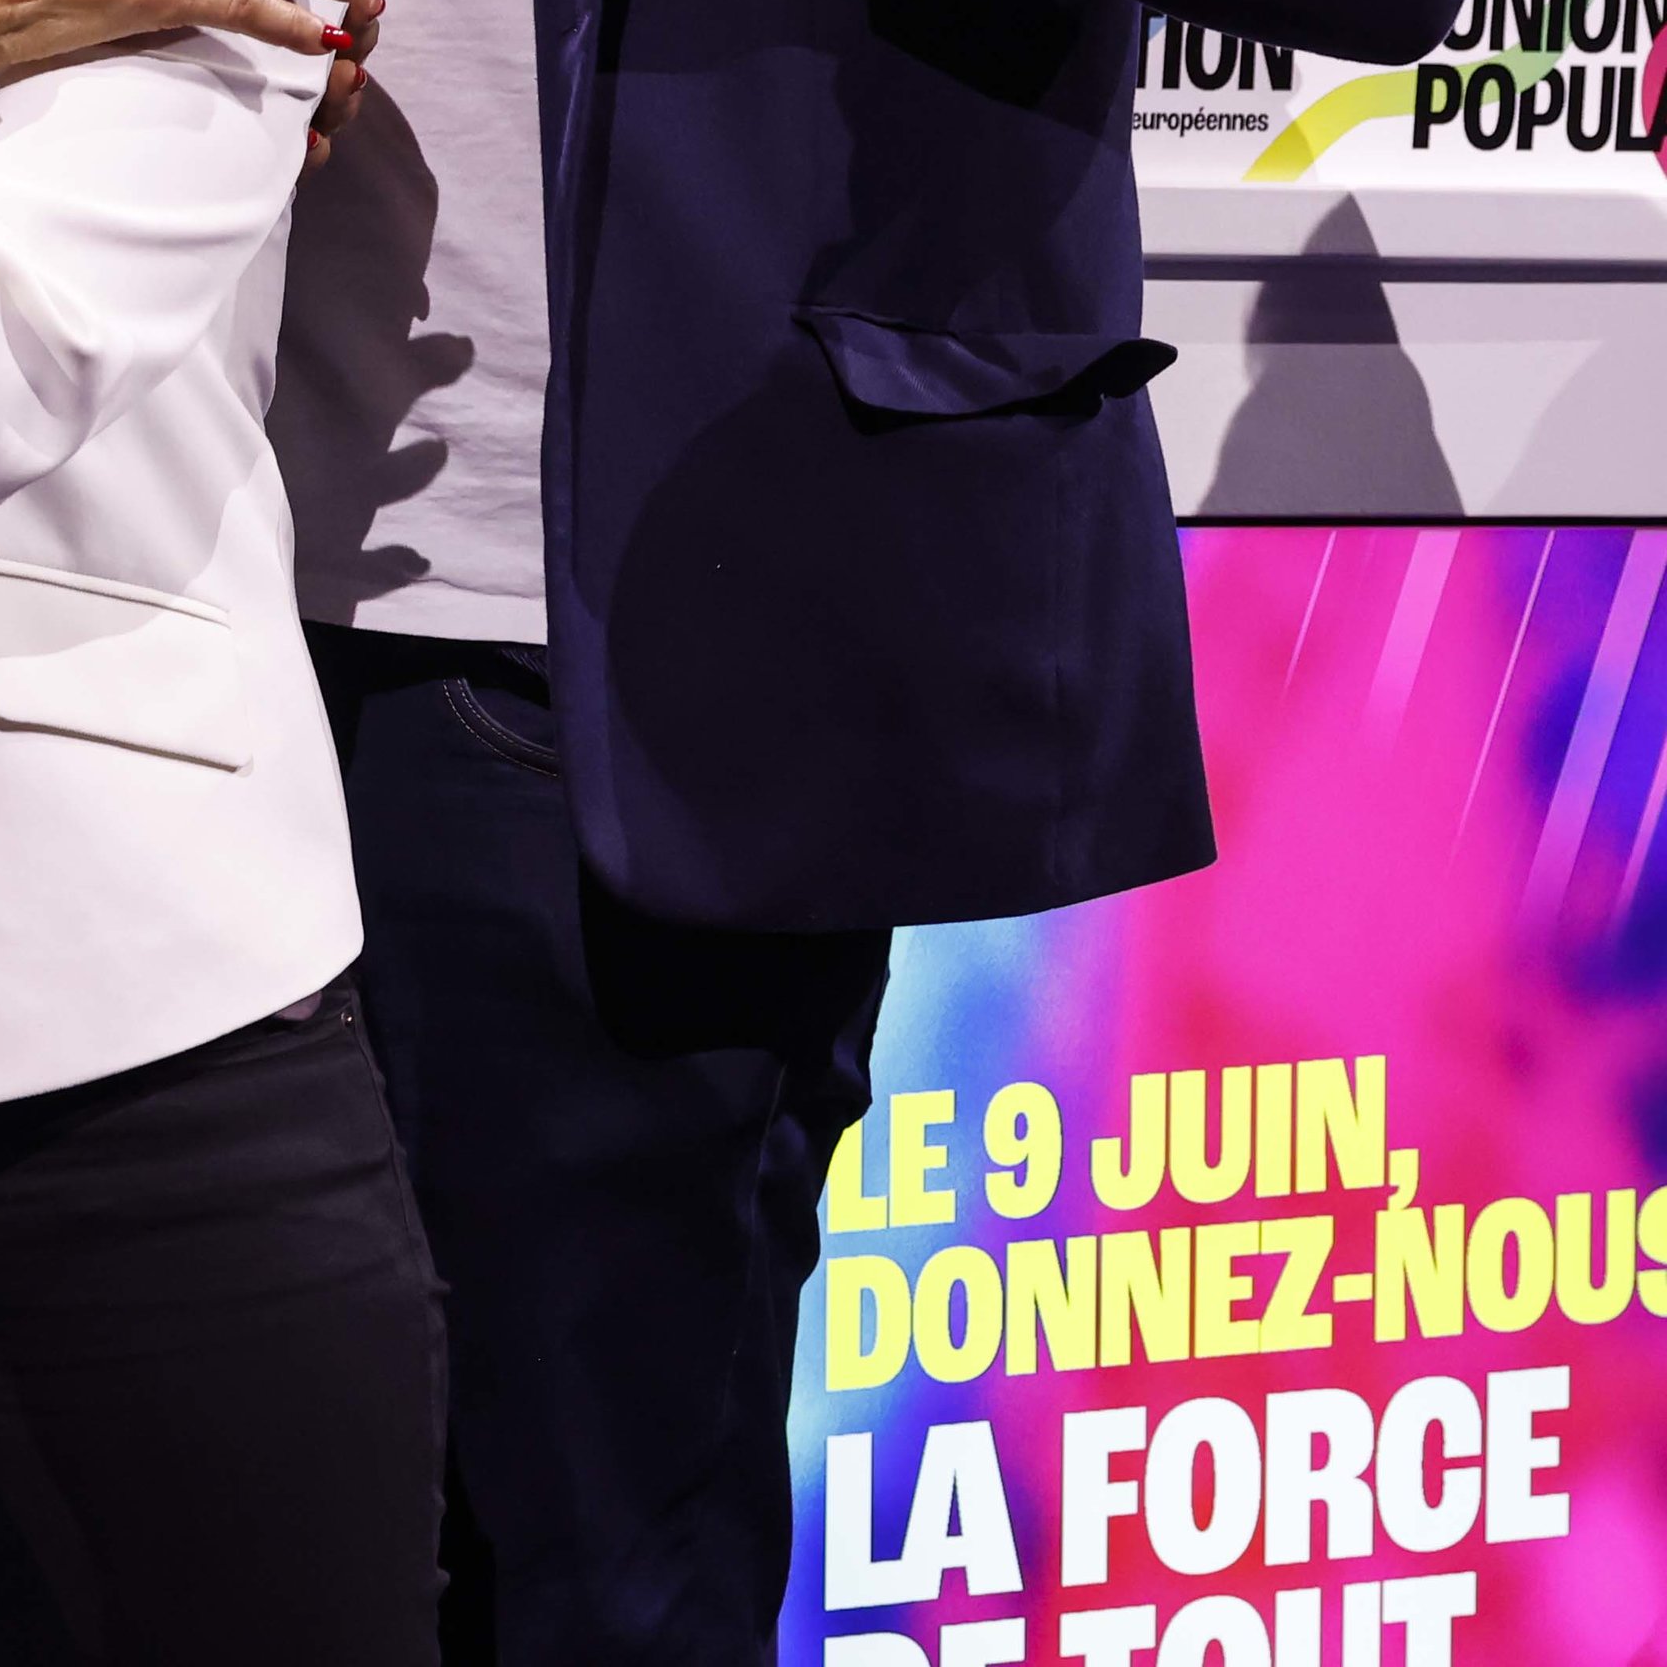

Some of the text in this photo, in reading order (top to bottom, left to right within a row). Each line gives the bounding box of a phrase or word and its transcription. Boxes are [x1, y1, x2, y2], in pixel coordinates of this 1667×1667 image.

[1132, 106, 1269, 137] européennes
[826, 1055, 1420, 1234] LE 9 JUIN,
[824, 1365, 1571, 1612] LA FORCE
